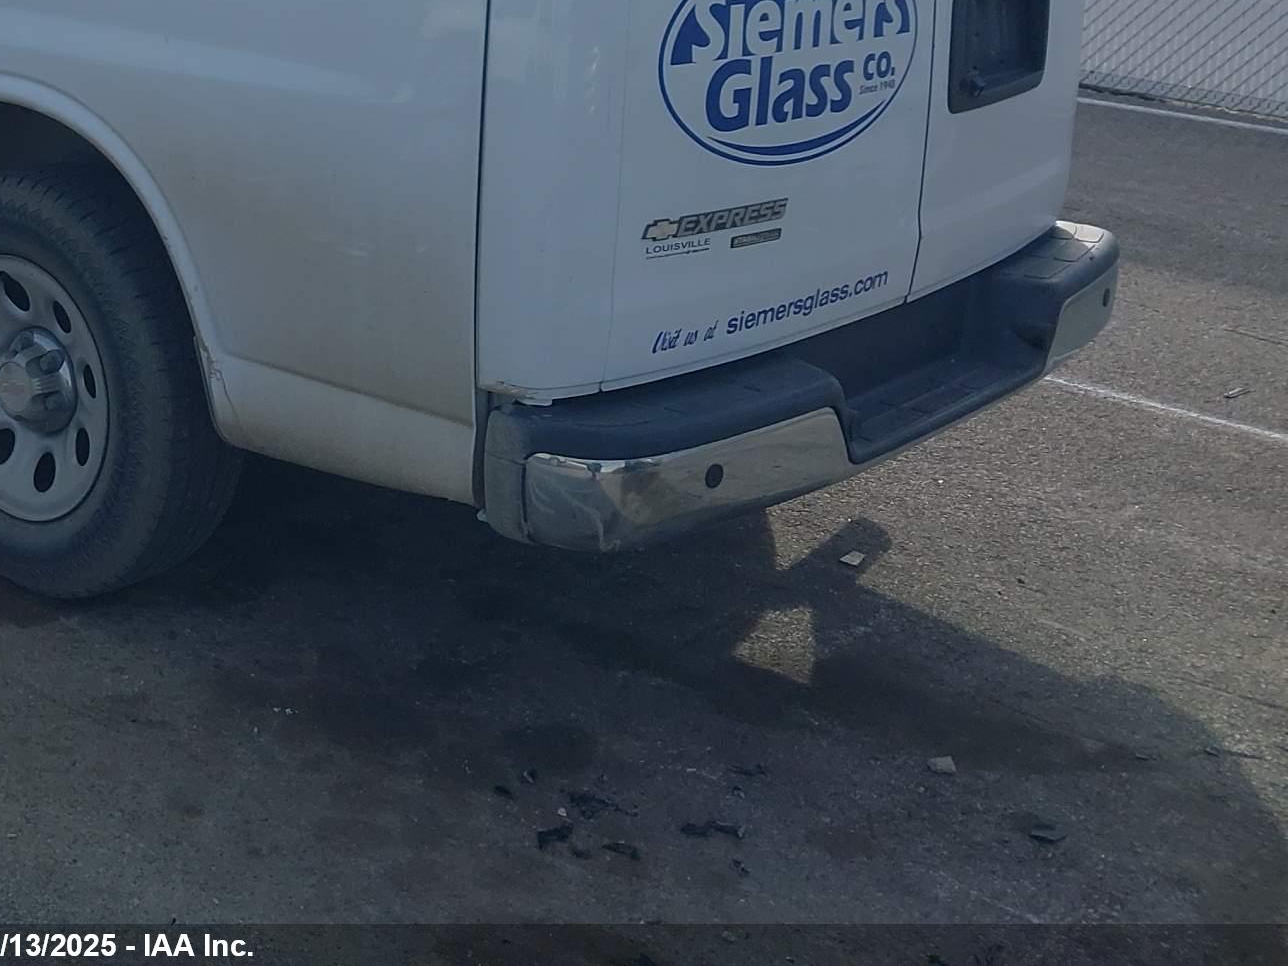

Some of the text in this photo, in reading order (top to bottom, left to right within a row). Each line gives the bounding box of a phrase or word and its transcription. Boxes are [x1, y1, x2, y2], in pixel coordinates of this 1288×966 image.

[705, 56, 854, 132] Glass
[645, 237, 711, 255] LOUISVILLE
[676, 199, 788, 237] EXPRESS
[683, 329, 698, 346] us
[726, 270, 889, 335] siemersglass.com
